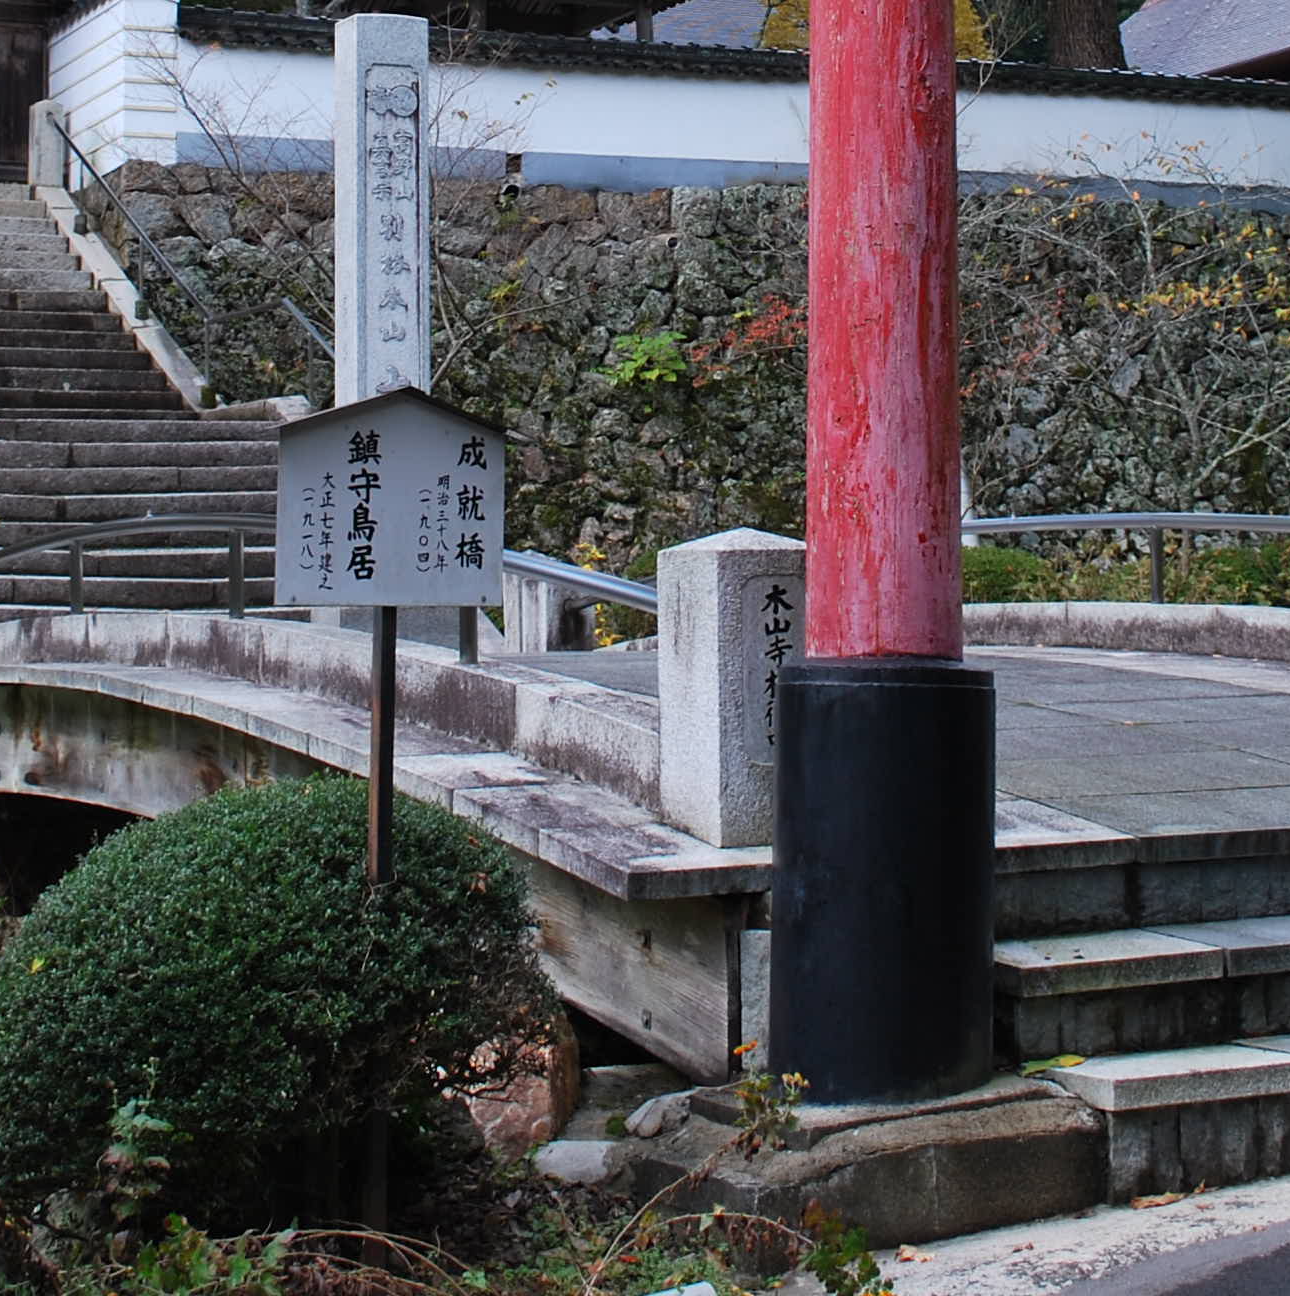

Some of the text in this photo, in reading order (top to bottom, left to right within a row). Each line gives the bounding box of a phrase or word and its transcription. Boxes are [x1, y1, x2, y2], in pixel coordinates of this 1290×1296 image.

[318, 472, 335, 590] 大正七年建之
[346, 429, 382, 580] 鎮守鳥居
[434, 474, 450, 573] 明治三十八年
[455, 435, 487, 570] 成就橋
